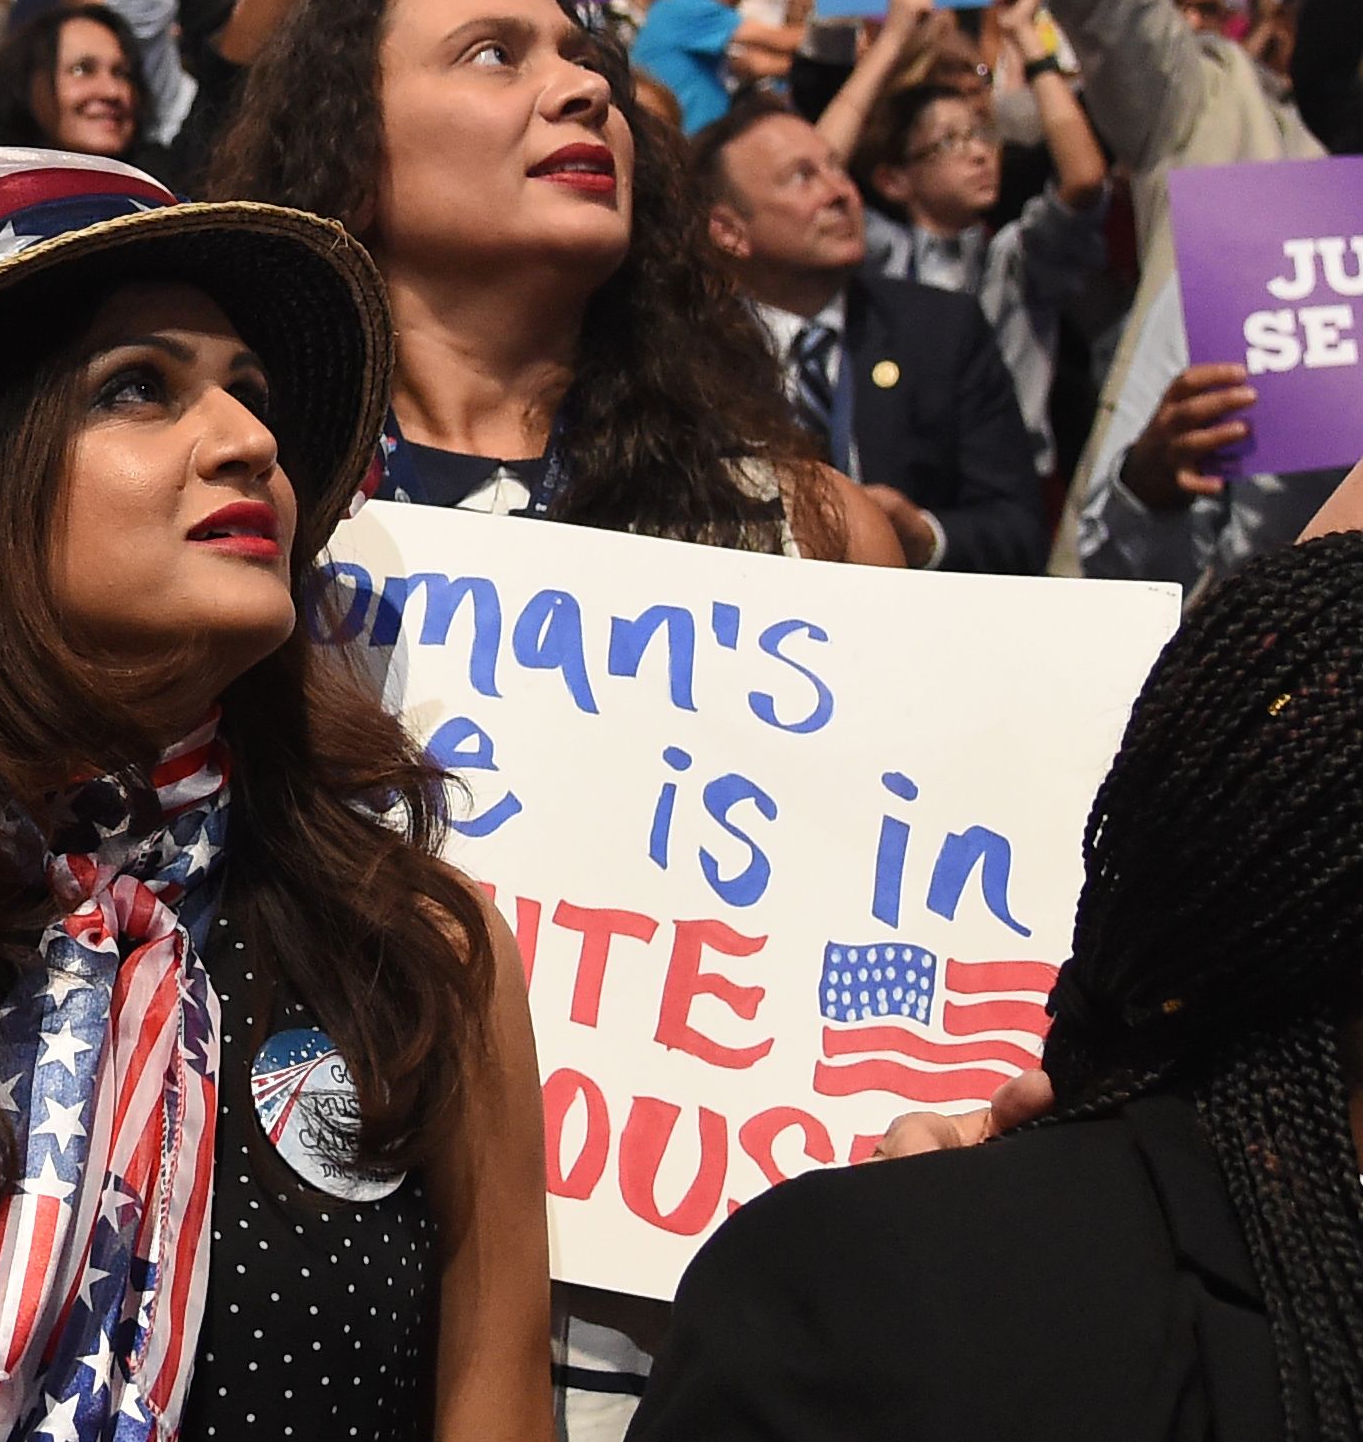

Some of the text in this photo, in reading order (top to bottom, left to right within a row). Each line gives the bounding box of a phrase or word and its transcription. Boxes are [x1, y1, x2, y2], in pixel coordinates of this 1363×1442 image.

[1243, 303, 1359, 375] SE
[308, 561, 835, 734] oman's
[649, 745, 779, 908] is
[872, 771, 1032, 939] in
[542, 1067, 884, 1236] OUS
